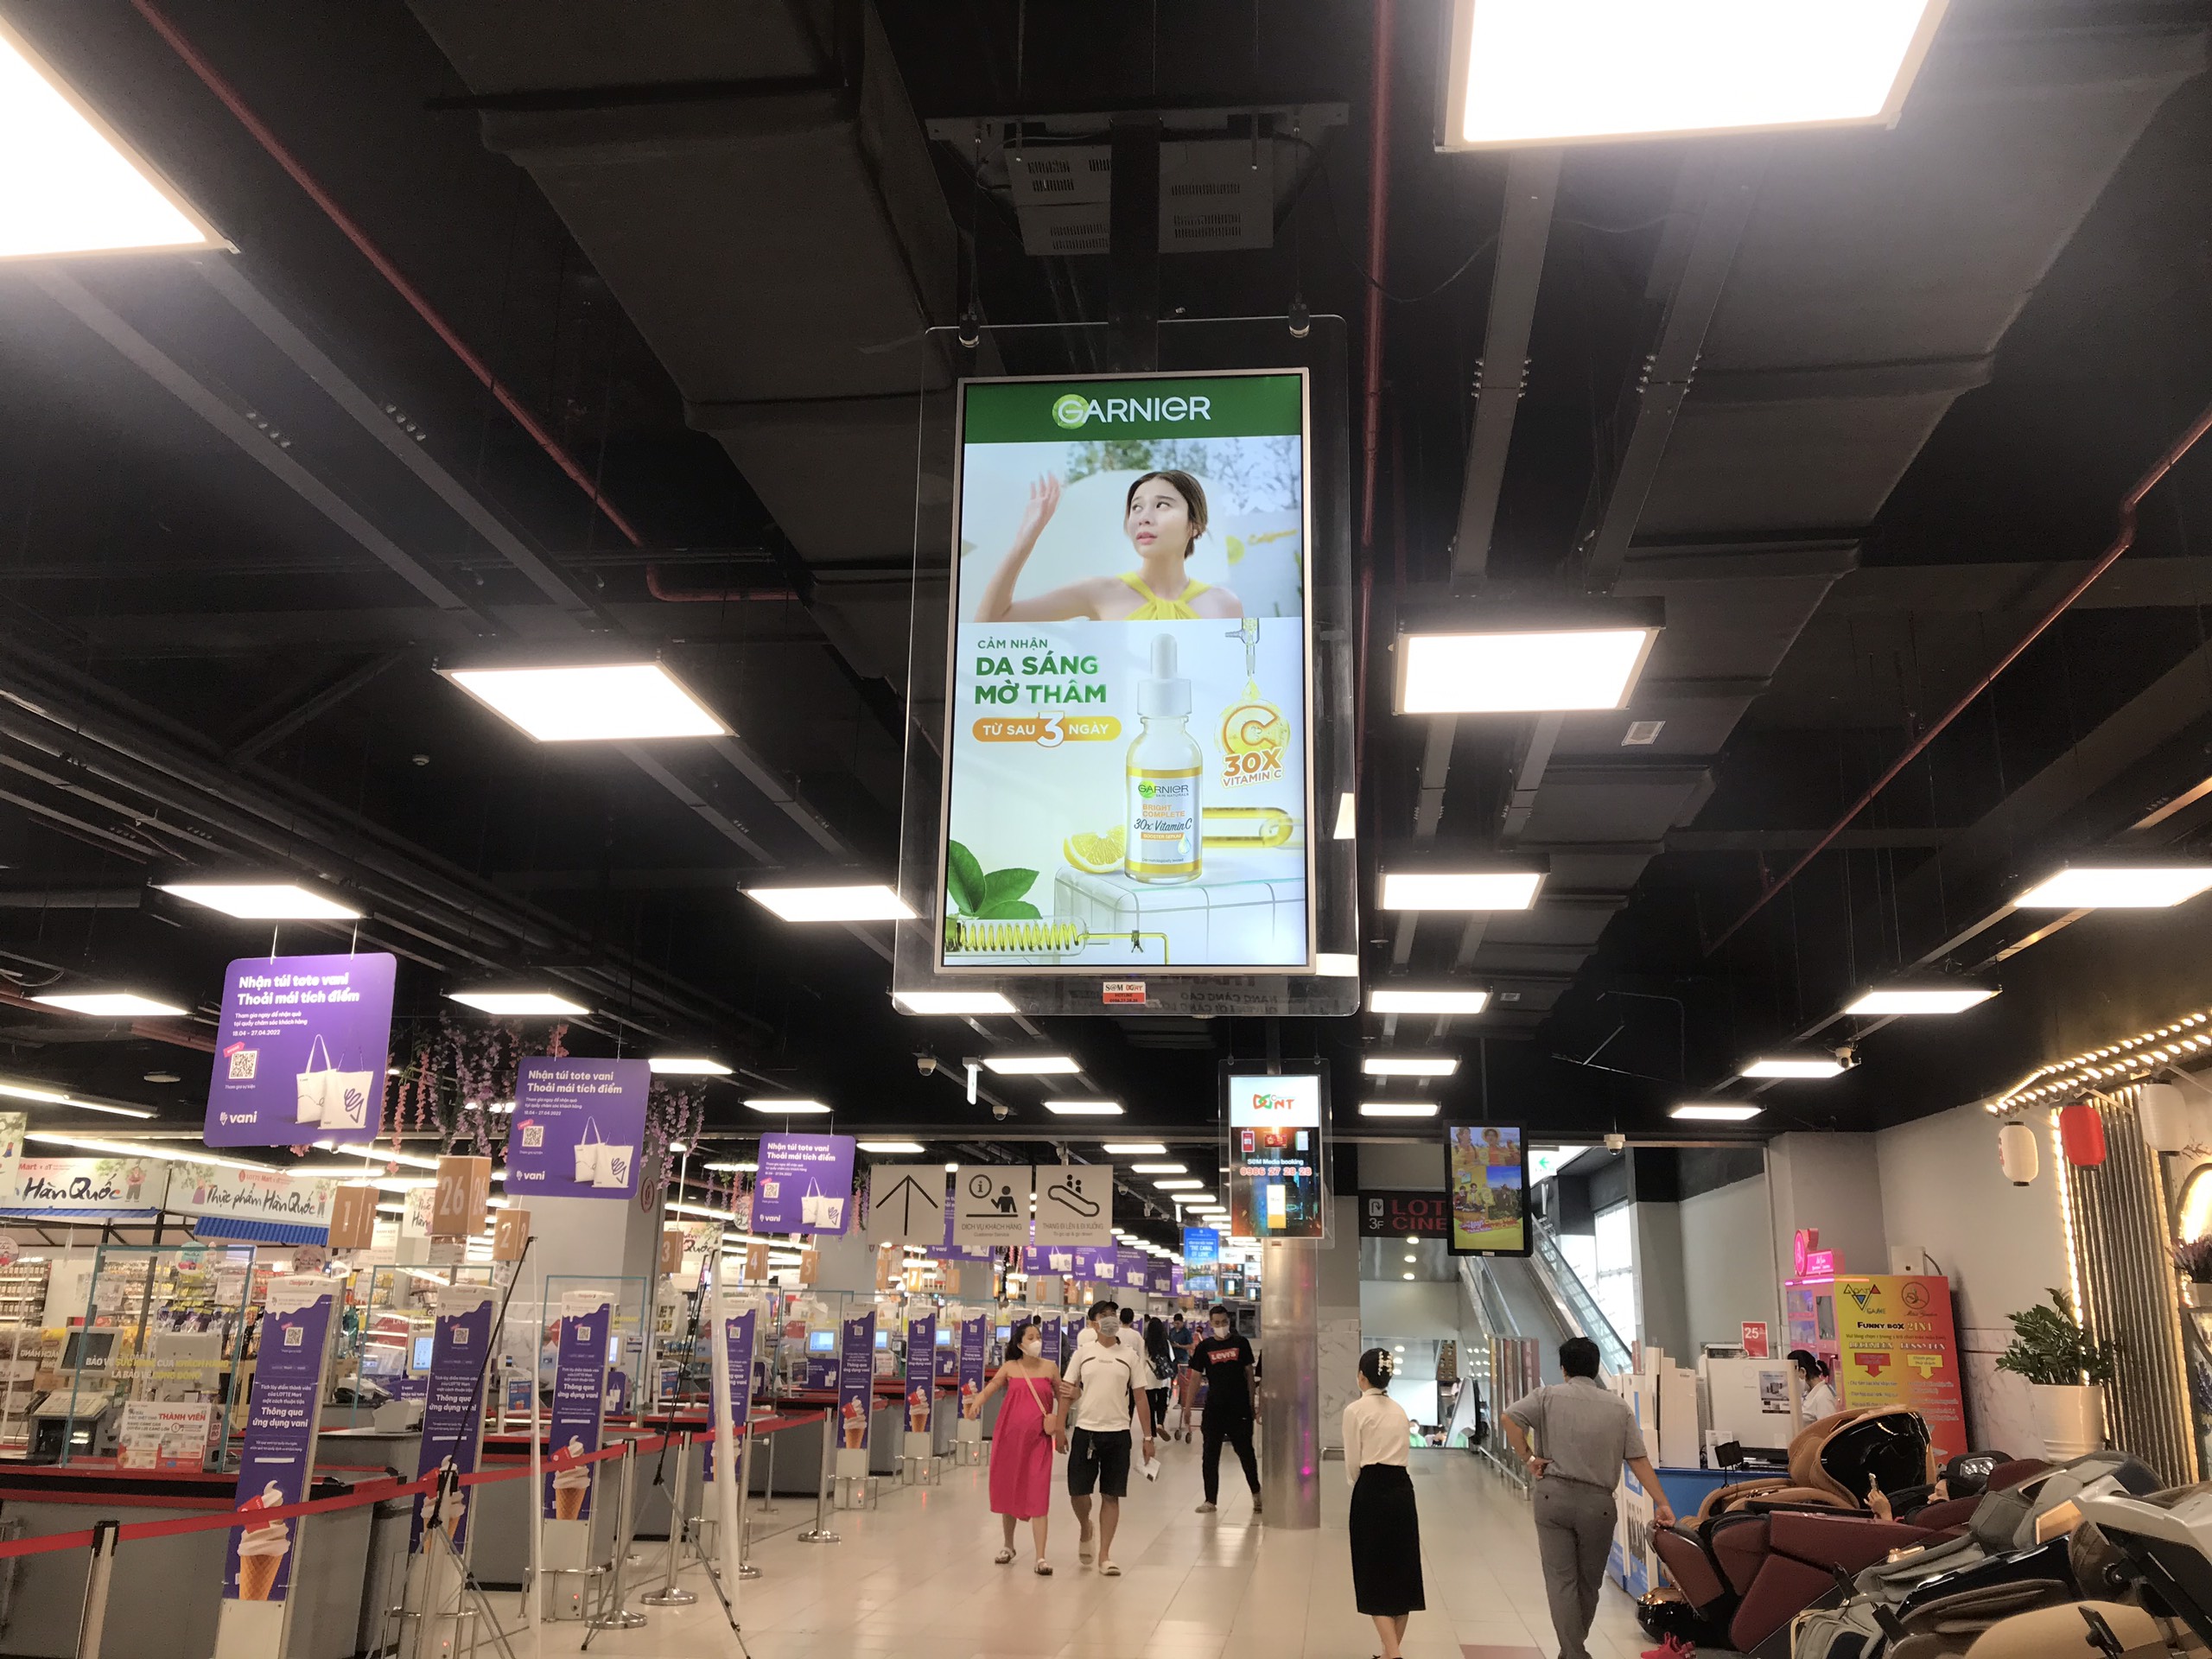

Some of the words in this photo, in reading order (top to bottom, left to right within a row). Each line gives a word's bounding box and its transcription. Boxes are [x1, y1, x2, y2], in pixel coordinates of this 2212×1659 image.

[1056, 395, 1211, 424] GARNIER
[977, 638, 1007, 650] CẢM
[1010, 638, 1048, 651] NHẬN
[976, 656, 1015, 677] DA
[1021, 651, 1098, 676] SÁNG
[975, 681, 1020, 705] MỜ
[1026, 679, 1107, 704] THÂM
[982, 721, 1005, 736] TỪ
[1007, 724, 1036, 736] SAU
[1036, 710, 1065, 748] 3
[1068, 721, 1110, 736] NGÀY
[1223, 748, 1282, 778] 30X
[1223, 772, 1271, 787] VITAMIN
[1274, 769, 1282, 779] C
[1137, 784, 1189, 794] GARNIER
[238, 975, 271, 991] Nhận
[274, 974, 292, 988] túi
[293, 975, 321, 987] tote
[321, 972, 350, 986] vani
[237, 991, 274, 1006] Thoải
[275, 990, 299, 1004] mái
[301, 989, 327, 1004] tích
[327, 987, 360, 1002] điểm
[528, 1070, 554, 1082] Nhận
[556, 1071, 569, 1080] túi
[570, 1071, 591, 1081] tote
[593, 1071, 614, 1081] vani
[527, 1082, 556, 1093] Thoải
[556, 1083, 575, 1093] mái
[576, 1084, 596, 1094] tích
[597, 1082, 623, 1094] điểm
[230, 1110, 258, 1124] vani
[767, 1142, 786, 1152] Nhận
[766, 1152, 788, 1160] Thoải
[802, 1153, 817, 1161] tích
[524, 1170, 546, 1181] vani
[22, 1177, 67, 1202] Hàn
[69, 1173, 123, 1202] Quốc
[232, 1183, 263, 1210] phẩm
[263, 1188, 288, 1212] Hàn
[288, 1191, 315, 1215] Quốc
[439, 1175, 466, 1217] 26
[472, 1176, 486, 1216] 26
[765, 1214, 781, 1223] vani
[1369, 1217, 1384, 1230] 3F
[500, 1221, 512, 1249] 2
[661, 1241, 671, 1262] 3
[750, 1251, 758, 1271] 4
[805, 1257, 812, 1276] 5
[1744, 1326, 1759, 1339] 25
[86, 1354, 103, 1366] BẢO
[563, 1383, 582, 1392] Thông
[435, 1394, 458, 1403] Thông
[158, 1411, 186, 1421] THÀNH
[188, 1412, 207, 1422] VIÊN
[261, 1407, 287, 1418] Thông
[288, 1408, 304, 1418] qua
[252, 1417, 269, 1428] ứng
[269, 1418, 290, 1429] dụng
[290, 1418, 308, 1427] vani
